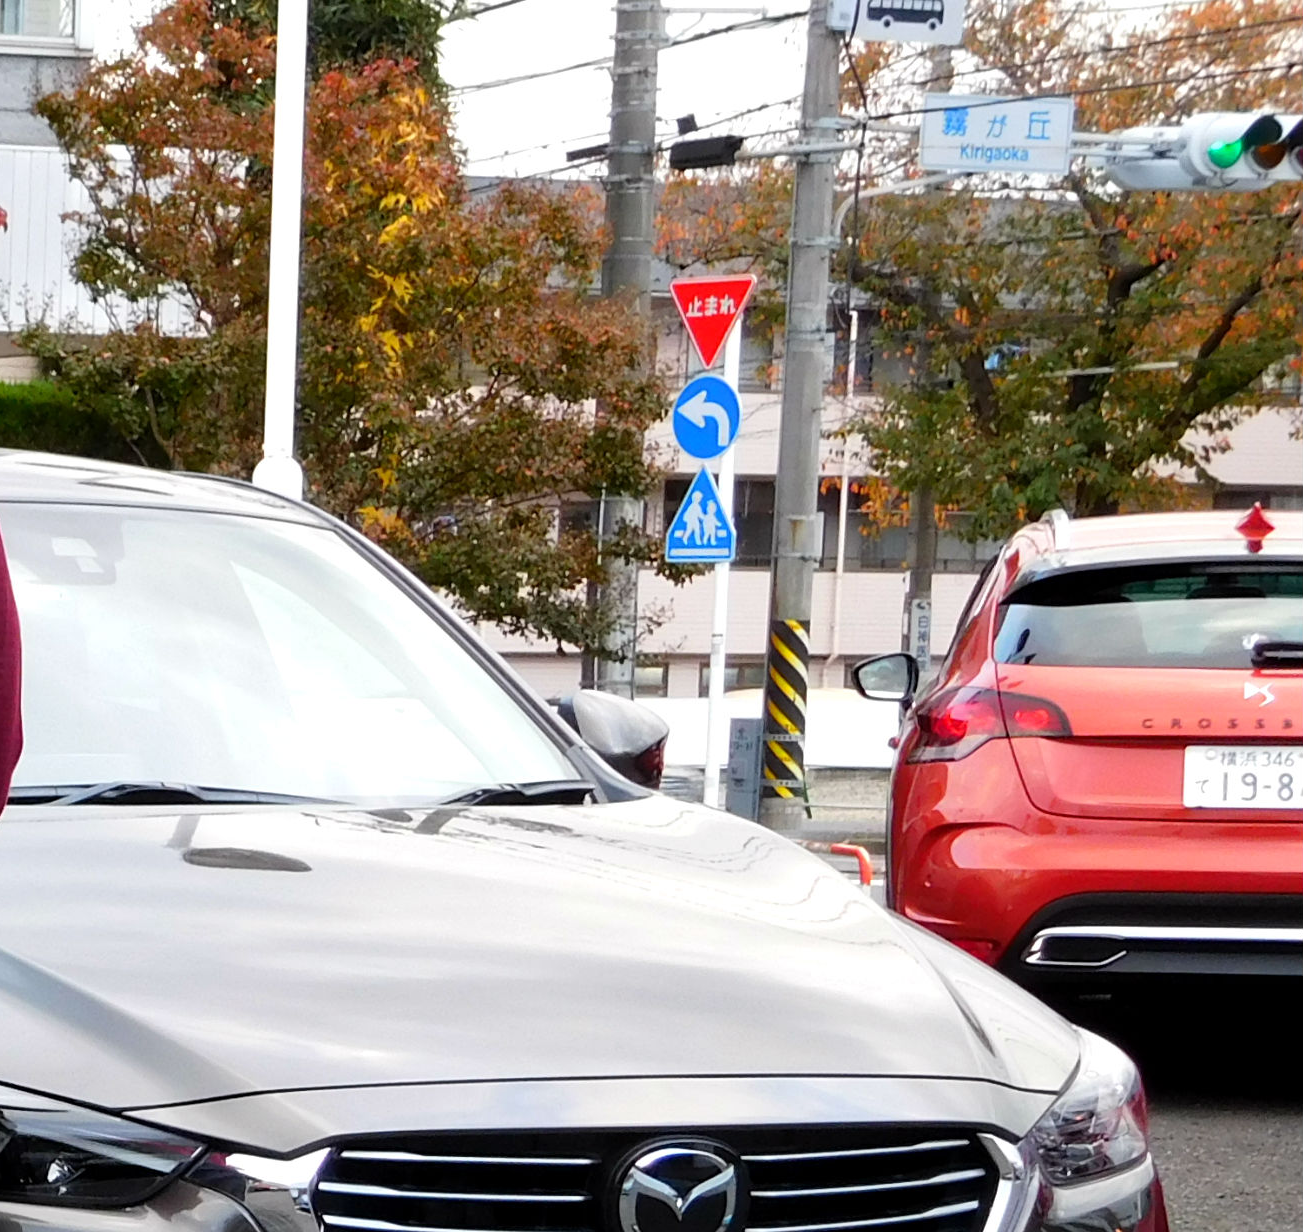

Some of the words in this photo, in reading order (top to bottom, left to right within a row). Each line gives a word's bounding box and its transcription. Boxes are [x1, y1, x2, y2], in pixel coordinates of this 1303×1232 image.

[960, 142, 1029, 163] Kirigaoka
[685, 294, 736, 317] 止まれ
[1222, 772, 1303, 801] 19-8
